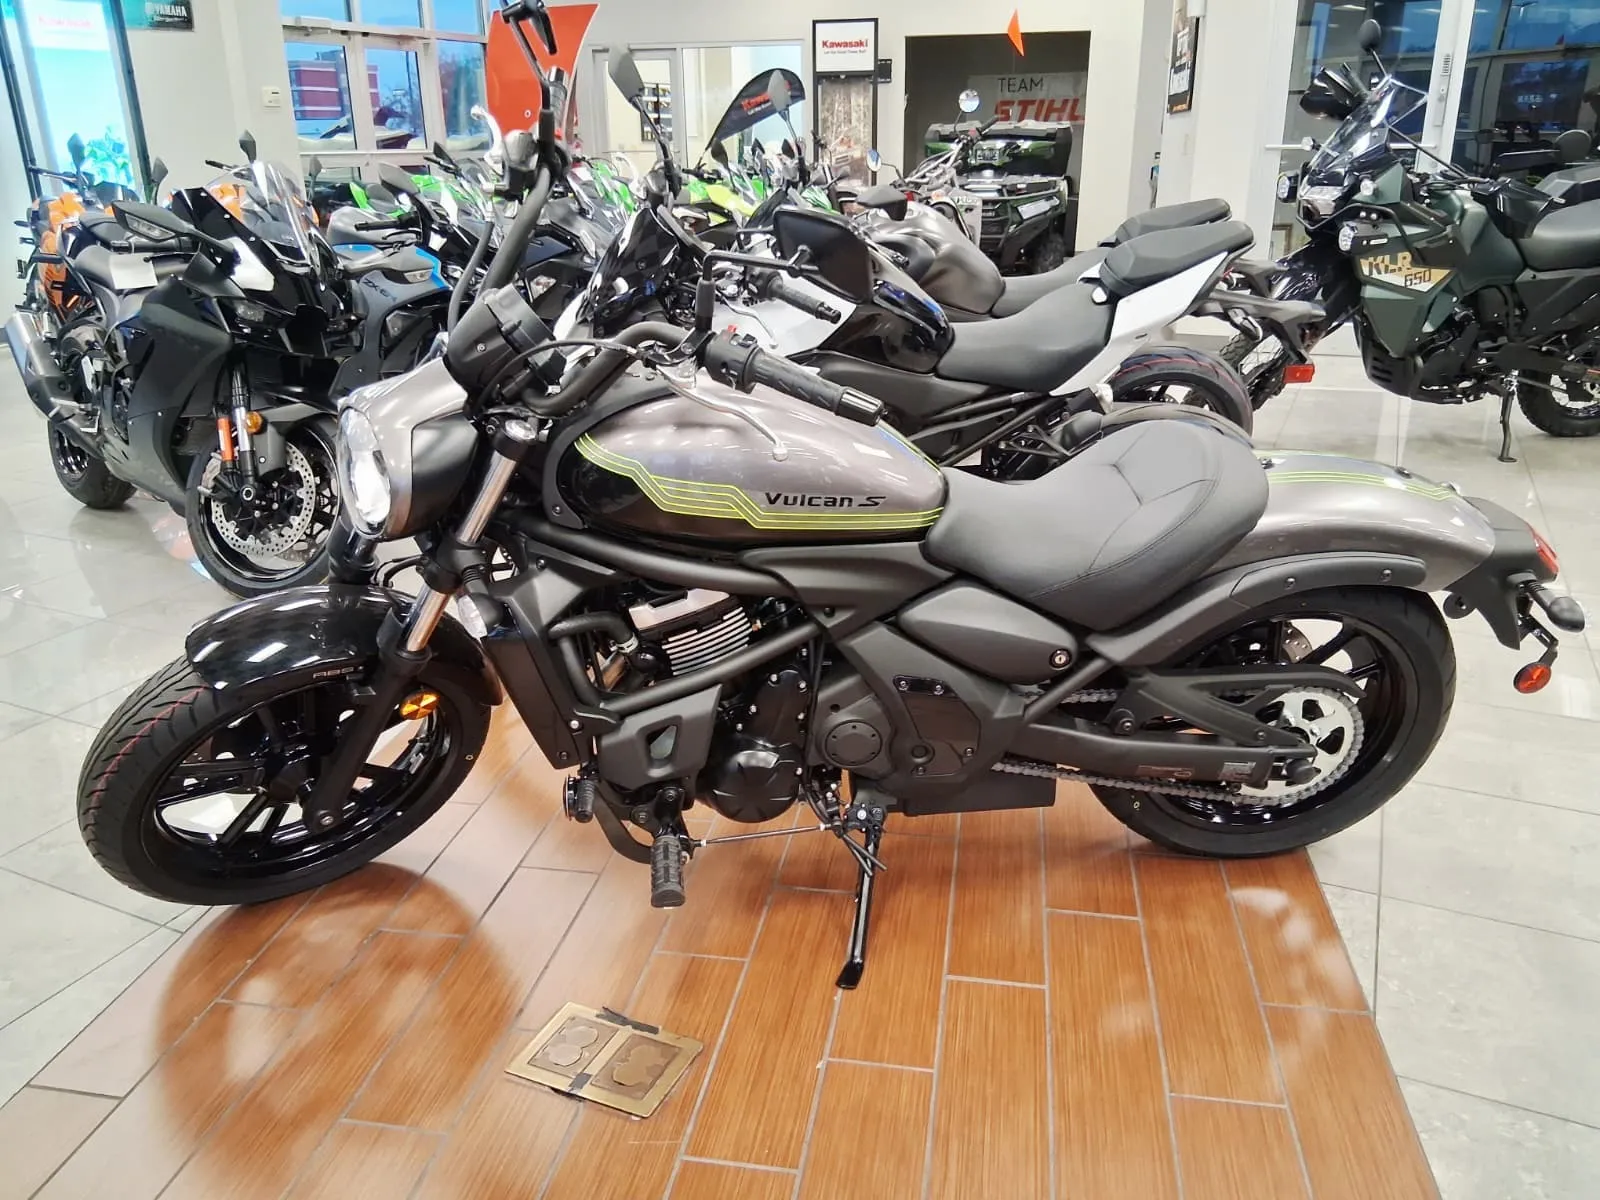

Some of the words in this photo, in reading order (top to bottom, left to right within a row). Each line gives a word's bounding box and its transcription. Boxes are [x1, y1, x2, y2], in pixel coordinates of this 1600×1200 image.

[822, 38, 869, 48] Kawasaki
[998, 77, 1043, 93] TEAM
[994, 98, 1085, 122] STIHL
[1368, 252, 1412, 276] KLR
[1405, 268, 1432, 288] 650
[765, 491, 853, 507] Vulcan
[857, 495, 887, 507] S
